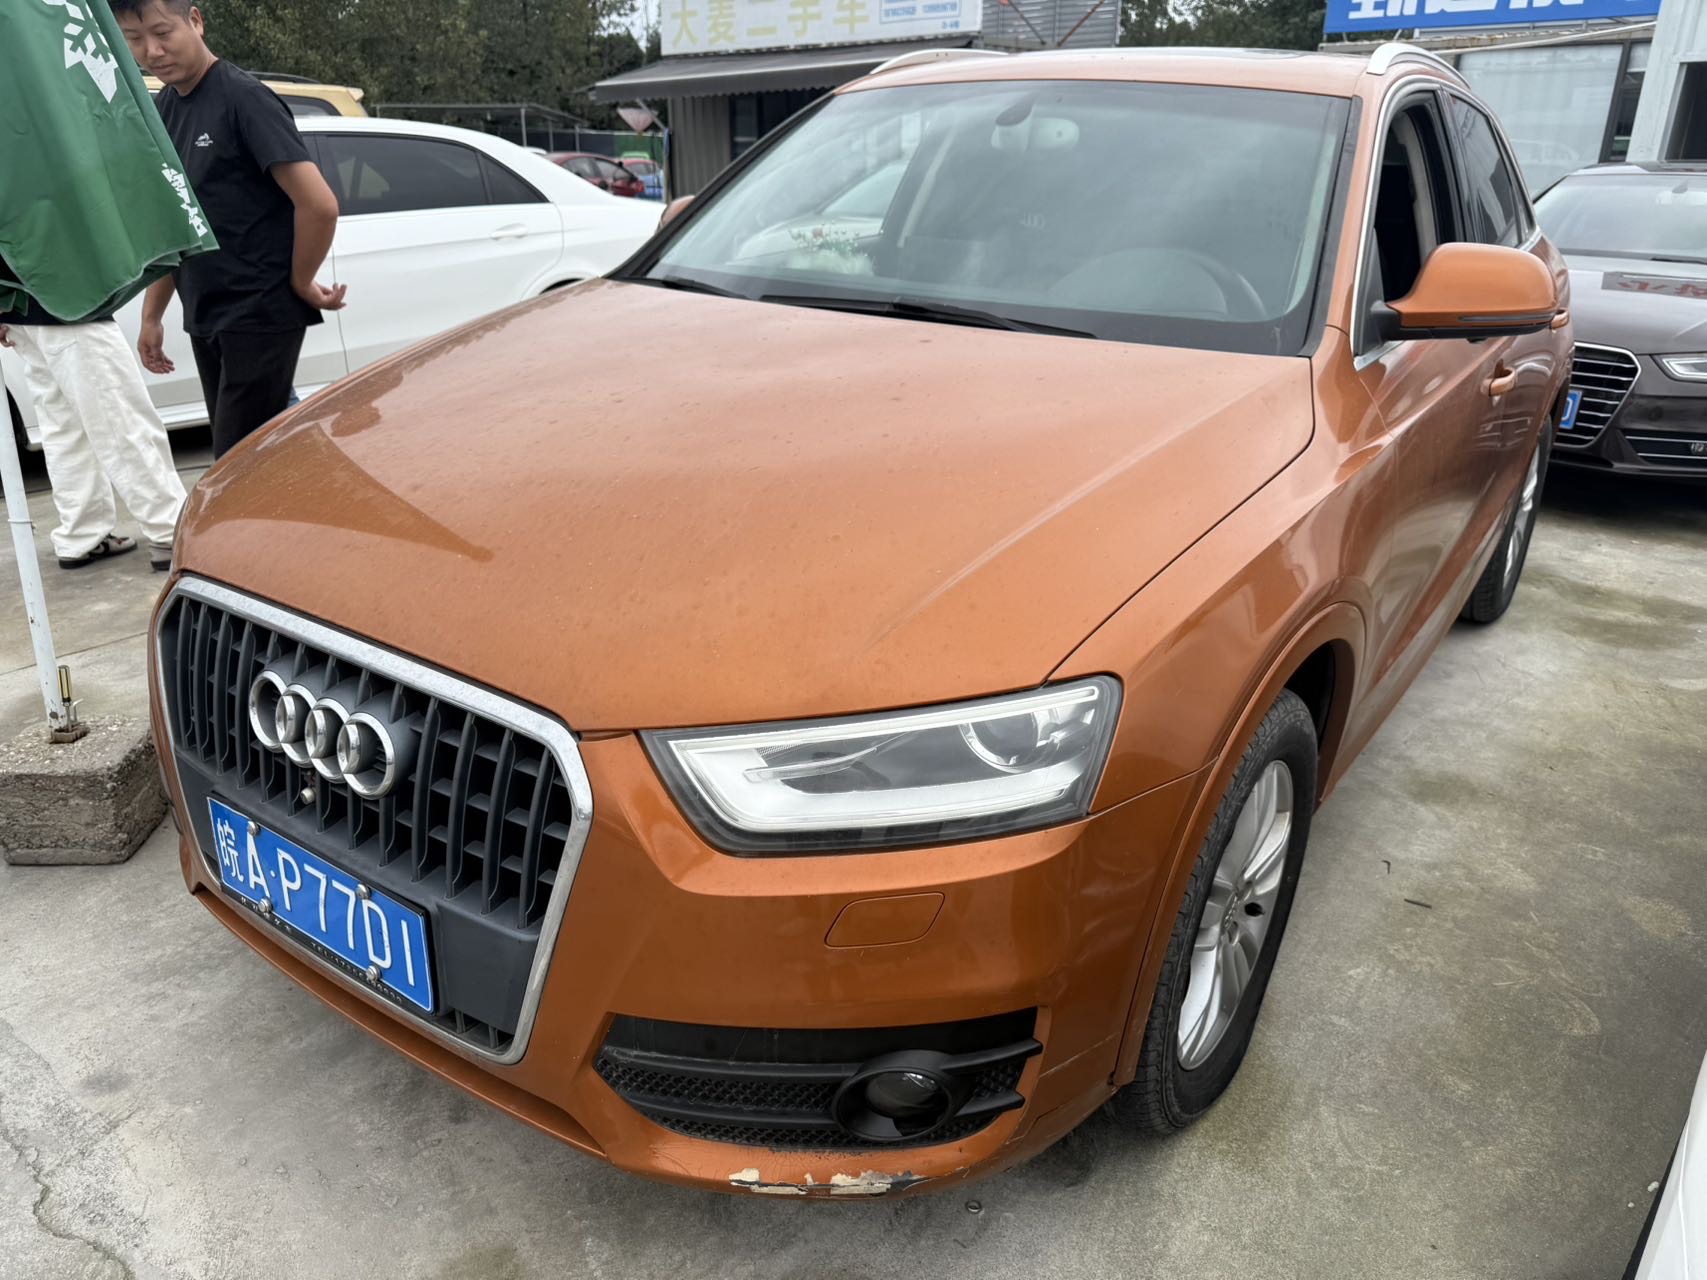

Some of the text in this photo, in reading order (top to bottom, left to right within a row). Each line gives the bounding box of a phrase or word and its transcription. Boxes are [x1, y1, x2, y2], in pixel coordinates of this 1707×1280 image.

[671, 0, 868, 46] 大麦二手车
